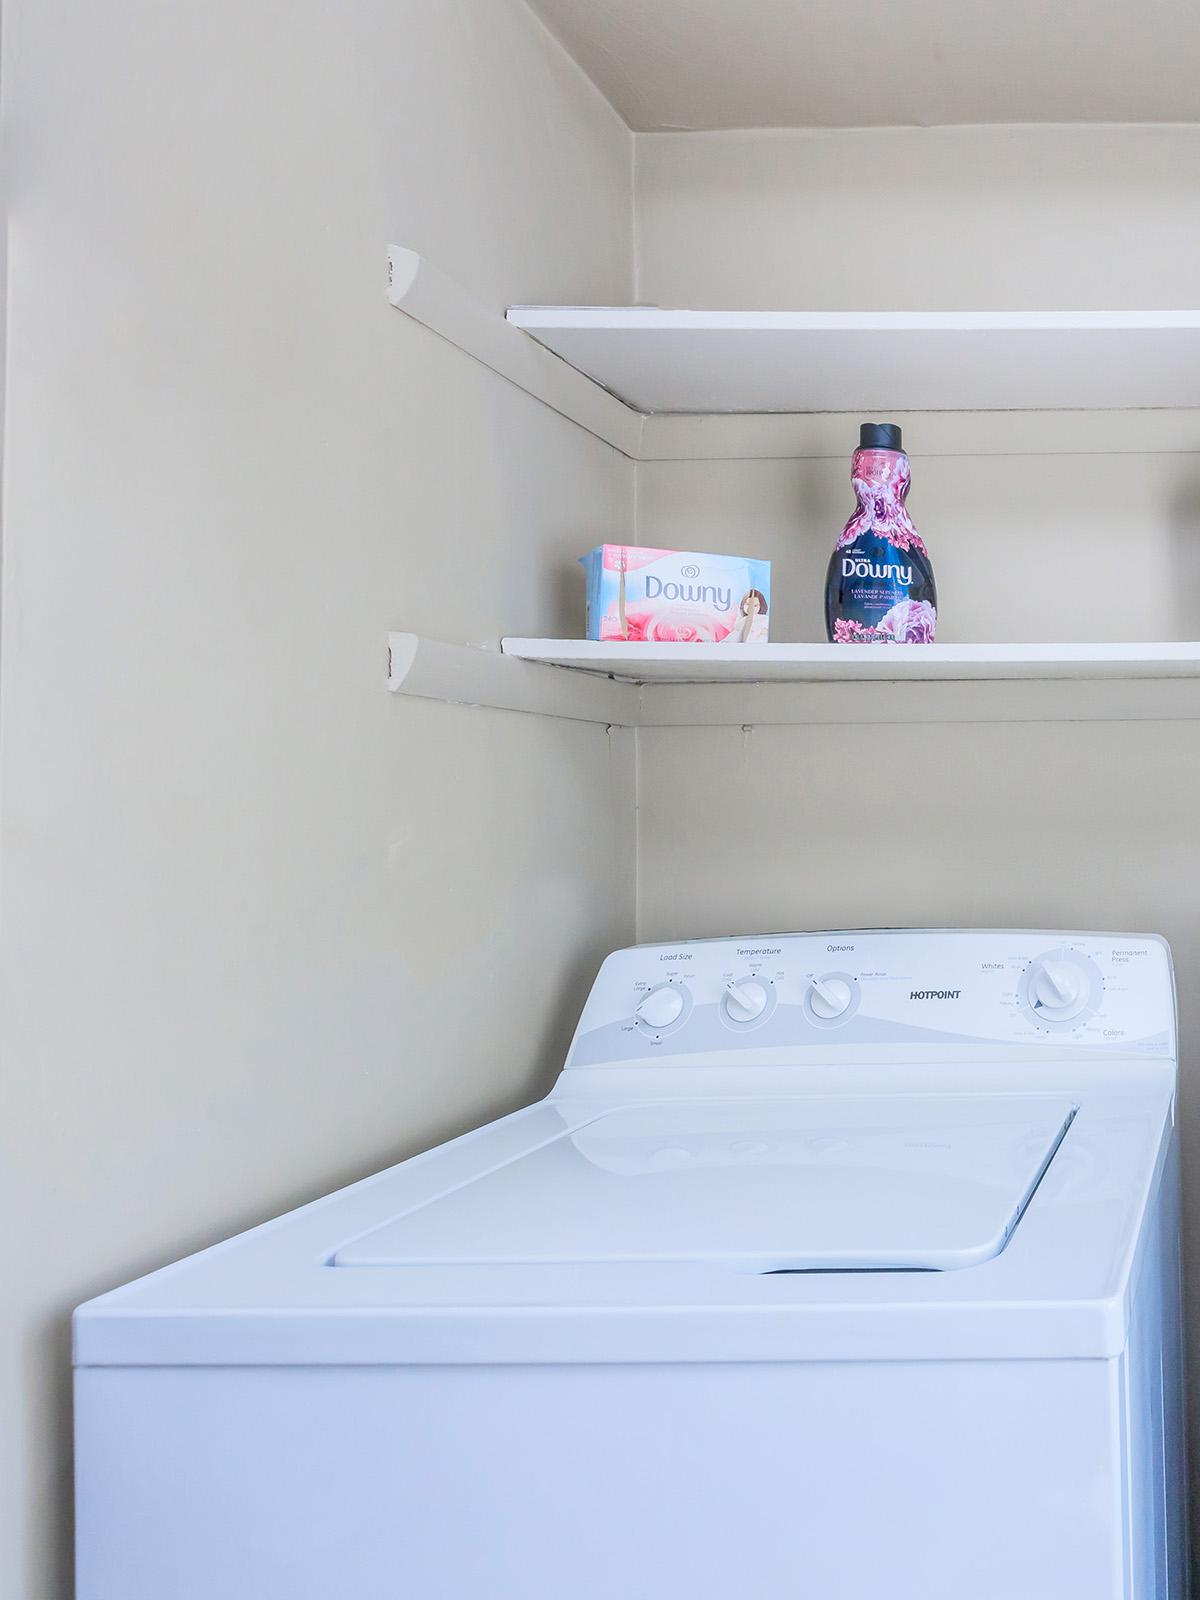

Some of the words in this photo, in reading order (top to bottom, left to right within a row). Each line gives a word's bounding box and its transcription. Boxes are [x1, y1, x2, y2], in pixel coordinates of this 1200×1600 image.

[842, 558, 914, 585] Downy
[645, 575, 731, 612] Downy
[659, 953, 677, 961] Load
[678, 952, 693, 960] Size
[736, 948, 782, 956] Temperature
[909, 990, 961, 1000] HOTPOINT
